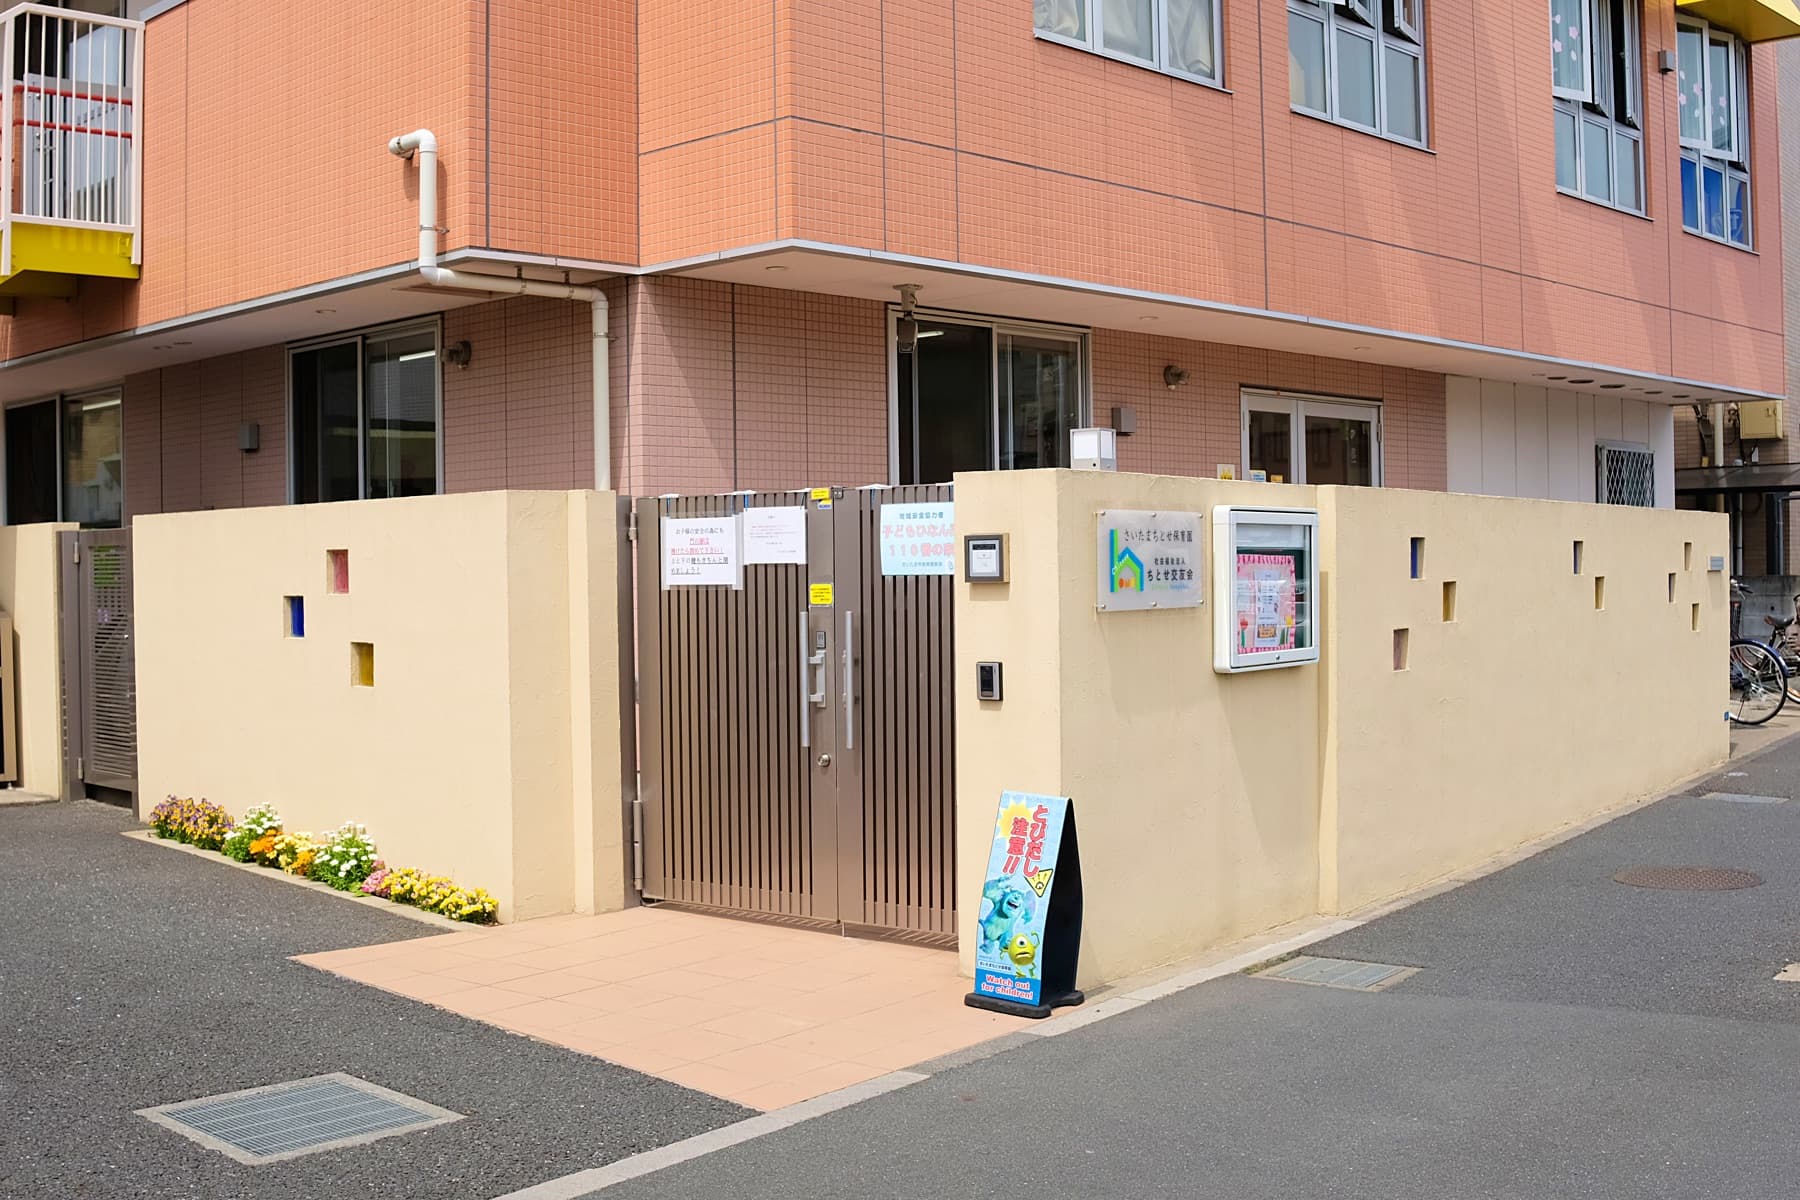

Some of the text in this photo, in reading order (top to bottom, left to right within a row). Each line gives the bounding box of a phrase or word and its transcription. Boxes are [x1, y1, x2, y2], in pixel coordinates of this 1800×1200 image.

[1124, 528, 1193, 542] さいたまちとせ保育園
[1154, 557, 1186, 565] 社会福祉法人
[1147, 568, 1193, 581] ちとせ交友会
[1023, 804, 1049, 877] とびだし
[985, 974, 1030, 991] Watch out
[981, 982, 1033, 1000] for children!
